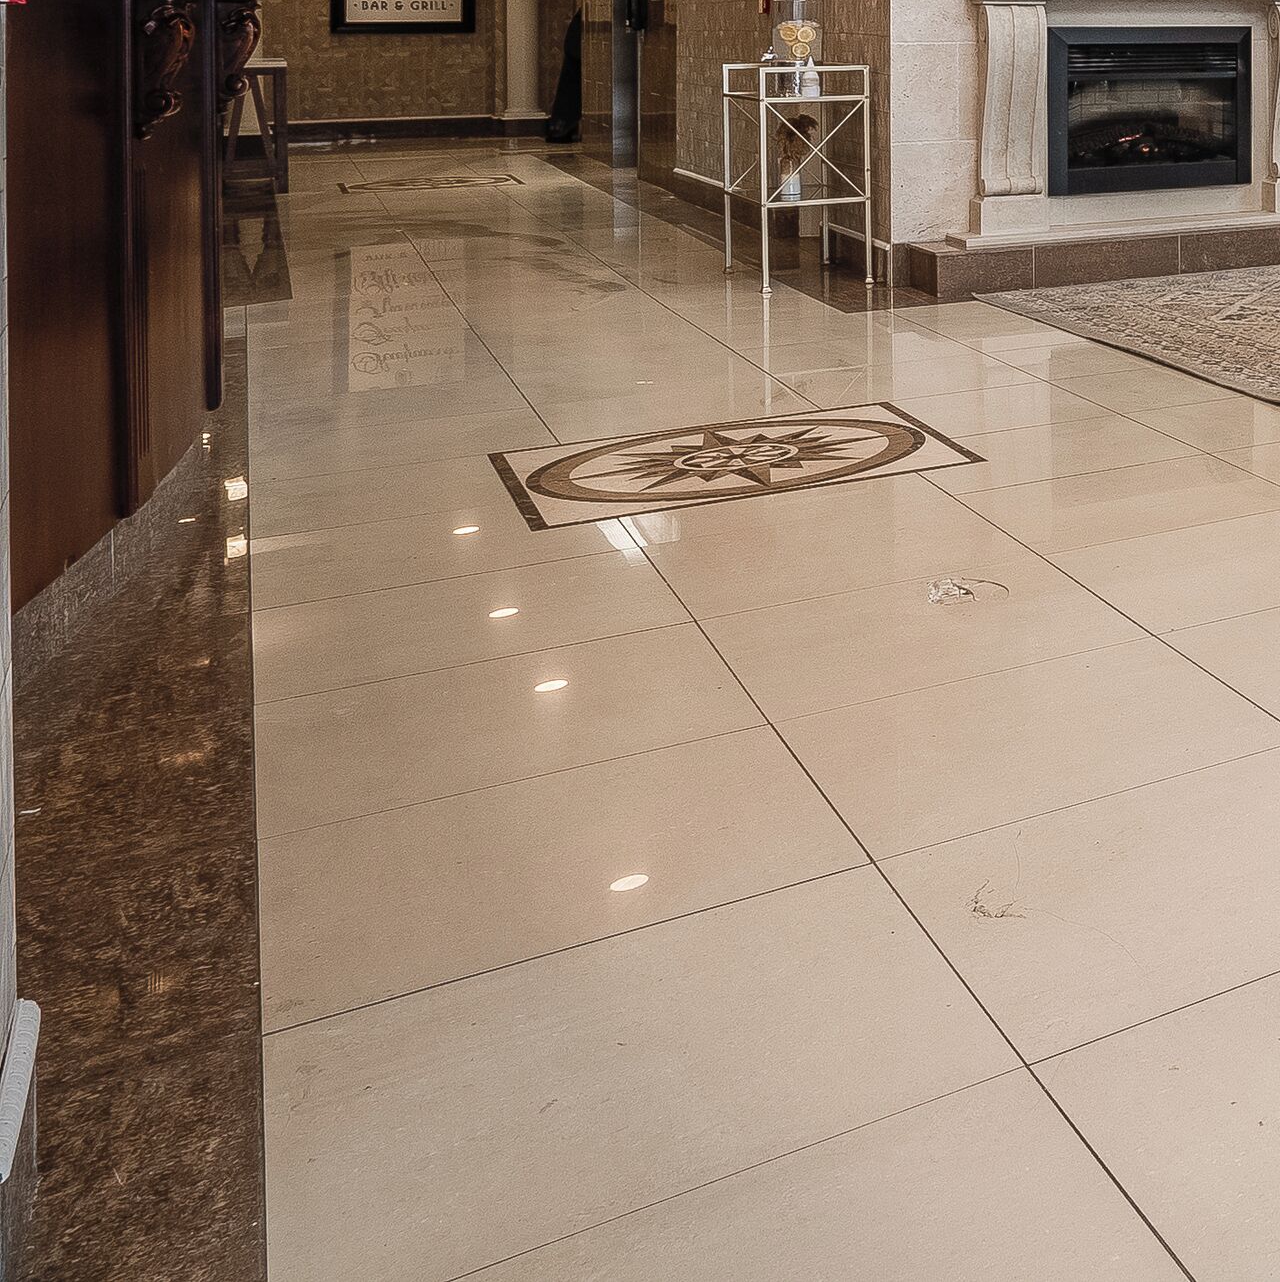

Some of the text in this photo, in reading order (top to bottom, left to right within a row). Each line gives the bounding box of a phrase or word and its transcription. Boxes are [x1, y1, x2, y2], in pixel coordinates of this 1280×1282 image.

[361, 0, 447, 11] BAR & GRILL
